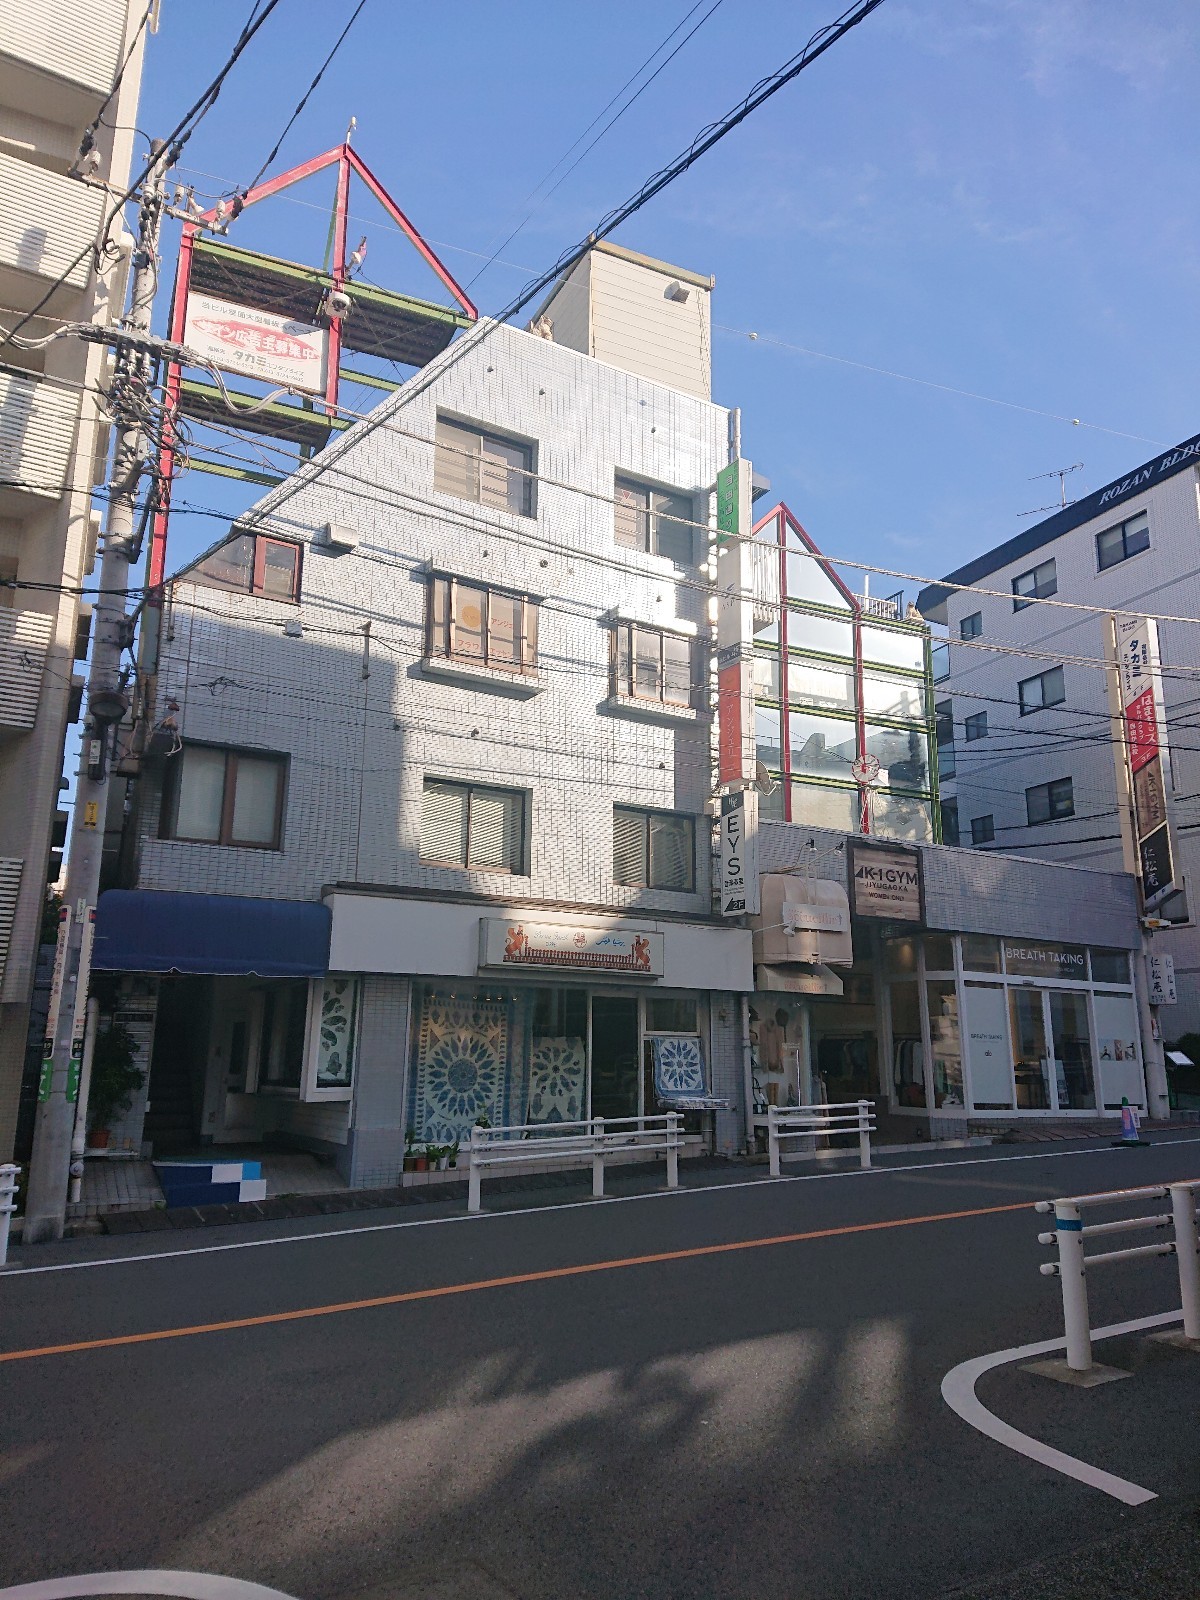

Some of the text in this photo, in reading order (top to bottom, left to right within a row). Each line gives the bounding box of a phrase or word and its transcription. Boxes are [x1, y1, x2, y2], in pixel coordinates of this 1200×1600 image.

[1099, 466, 1154, 505] ROZAN
[727, 814, 741, 876] EYS
[864, 867, 918, 886] K-1 GYM
[864, 881, 909, 893] JIYUGAOKA
[732, 901, 744, 910] 2F
[1005, 947, 1084, 965] BREATH TAKING
